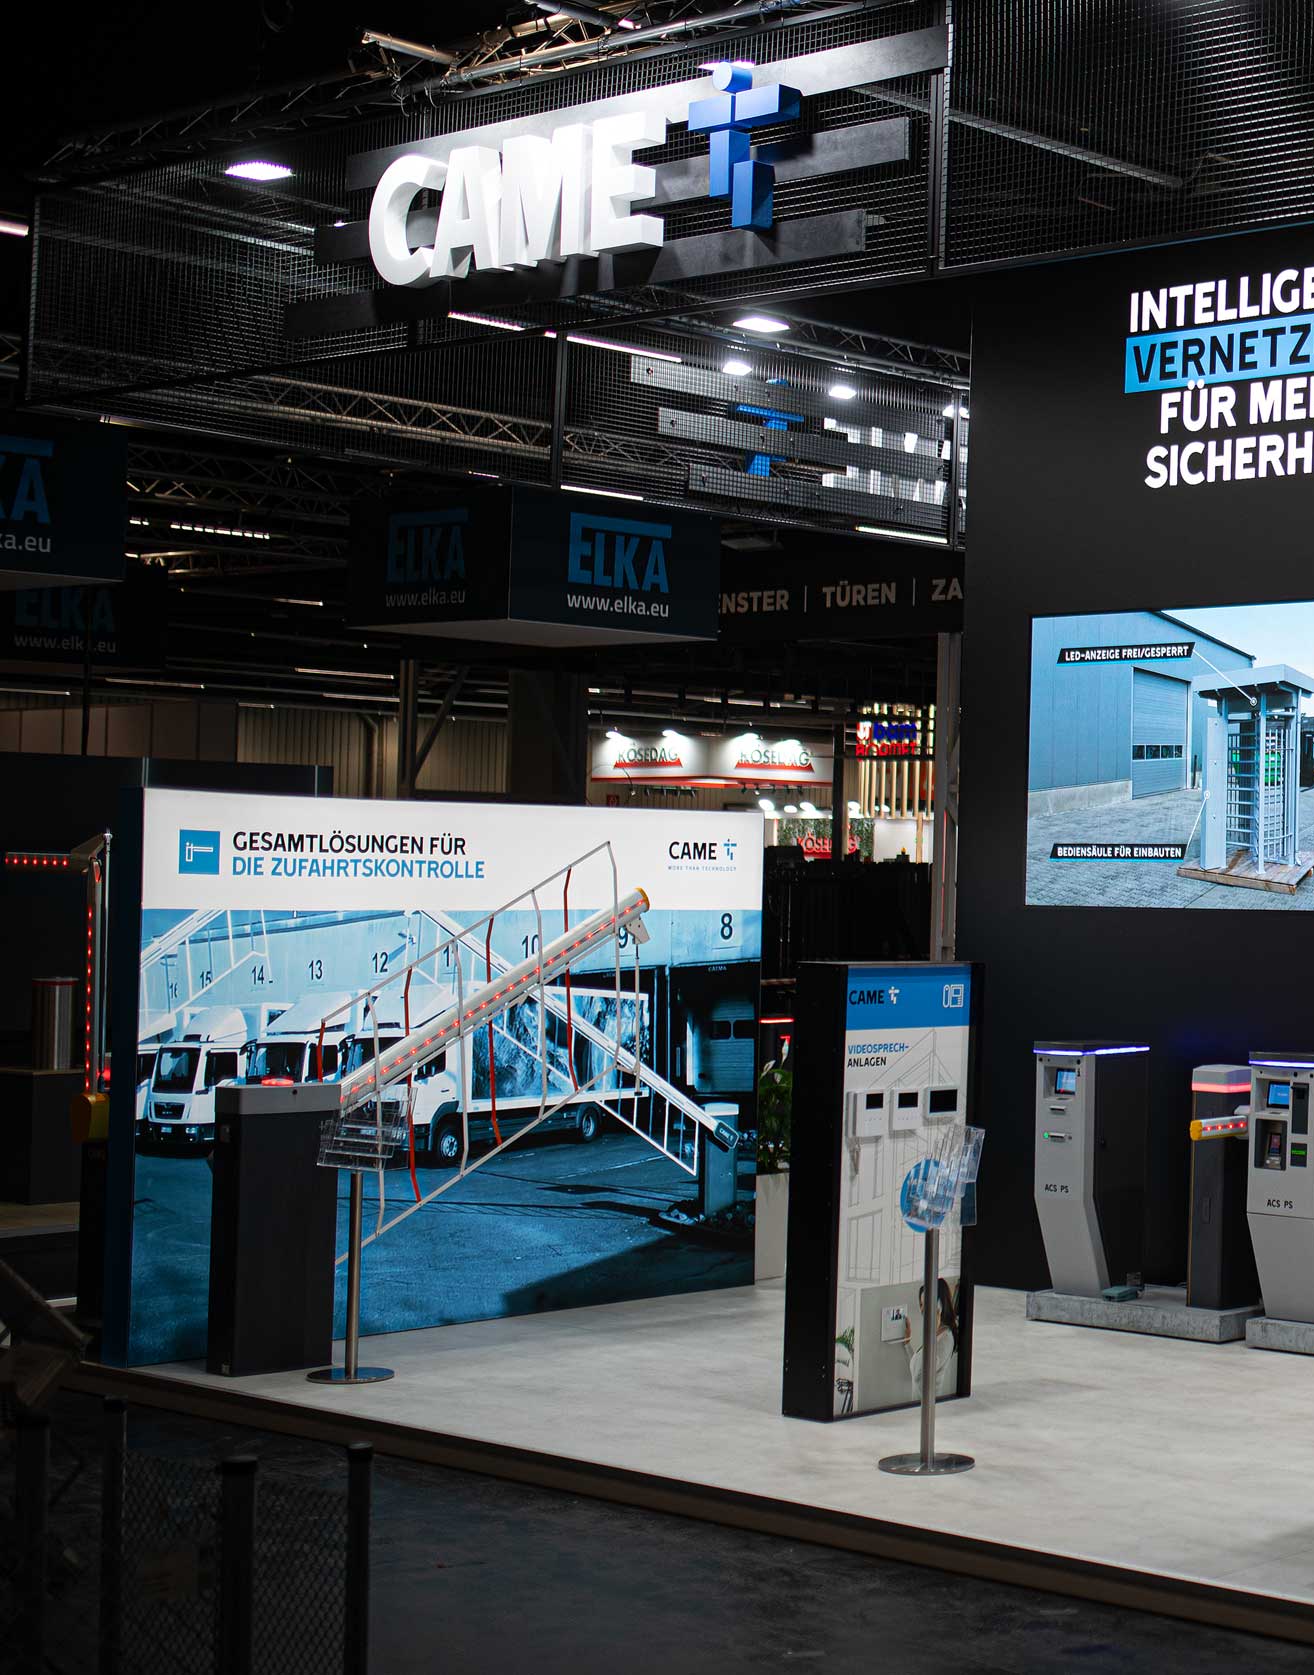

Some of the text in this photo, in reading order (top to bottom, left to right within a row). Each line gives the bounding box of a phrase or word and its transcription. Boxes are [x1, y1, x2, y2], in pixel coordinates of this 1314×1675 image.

[368, 111, 667, 289] CAME
[1160, 379, 1237, 434] FÜR
[567, 511, 673, 593] ELKA
[821, 580, 897, 608] TÜREN
[567, 593, 670, 618] www.elka.eu
[14, 633, 117, 654] www.elk.eu
[1065, 646, 1189, 662] LED-ANZEIGE FREI/GESPERRT
[232, 830, 467, 855] GESAMTLÖSUNGEN FÜR
[668, 841, 718, 861] CAME
[1057, 845, 1182, 858] BEDIENSÄULE FÜR EINBAUTEN
[232, 856, 486, 880] DIE ZUFAHRTSKONTROLLE
[720, 912, 733, 940] 8
[309, 959, 323, 981] 13
[372, 952, 389, 975] 12
[251, 965, 265, 985] 14
[848, 989, 885, 1006] CAME
[848, 1042, 909, 1055] VIDEOSPRECH-
[847, 1056, 887, 1068] ANLAGEN
[1044, 1183, 1069, 1194] ACS PS
[1266, 1199, 1293, 1209] ACS PS
